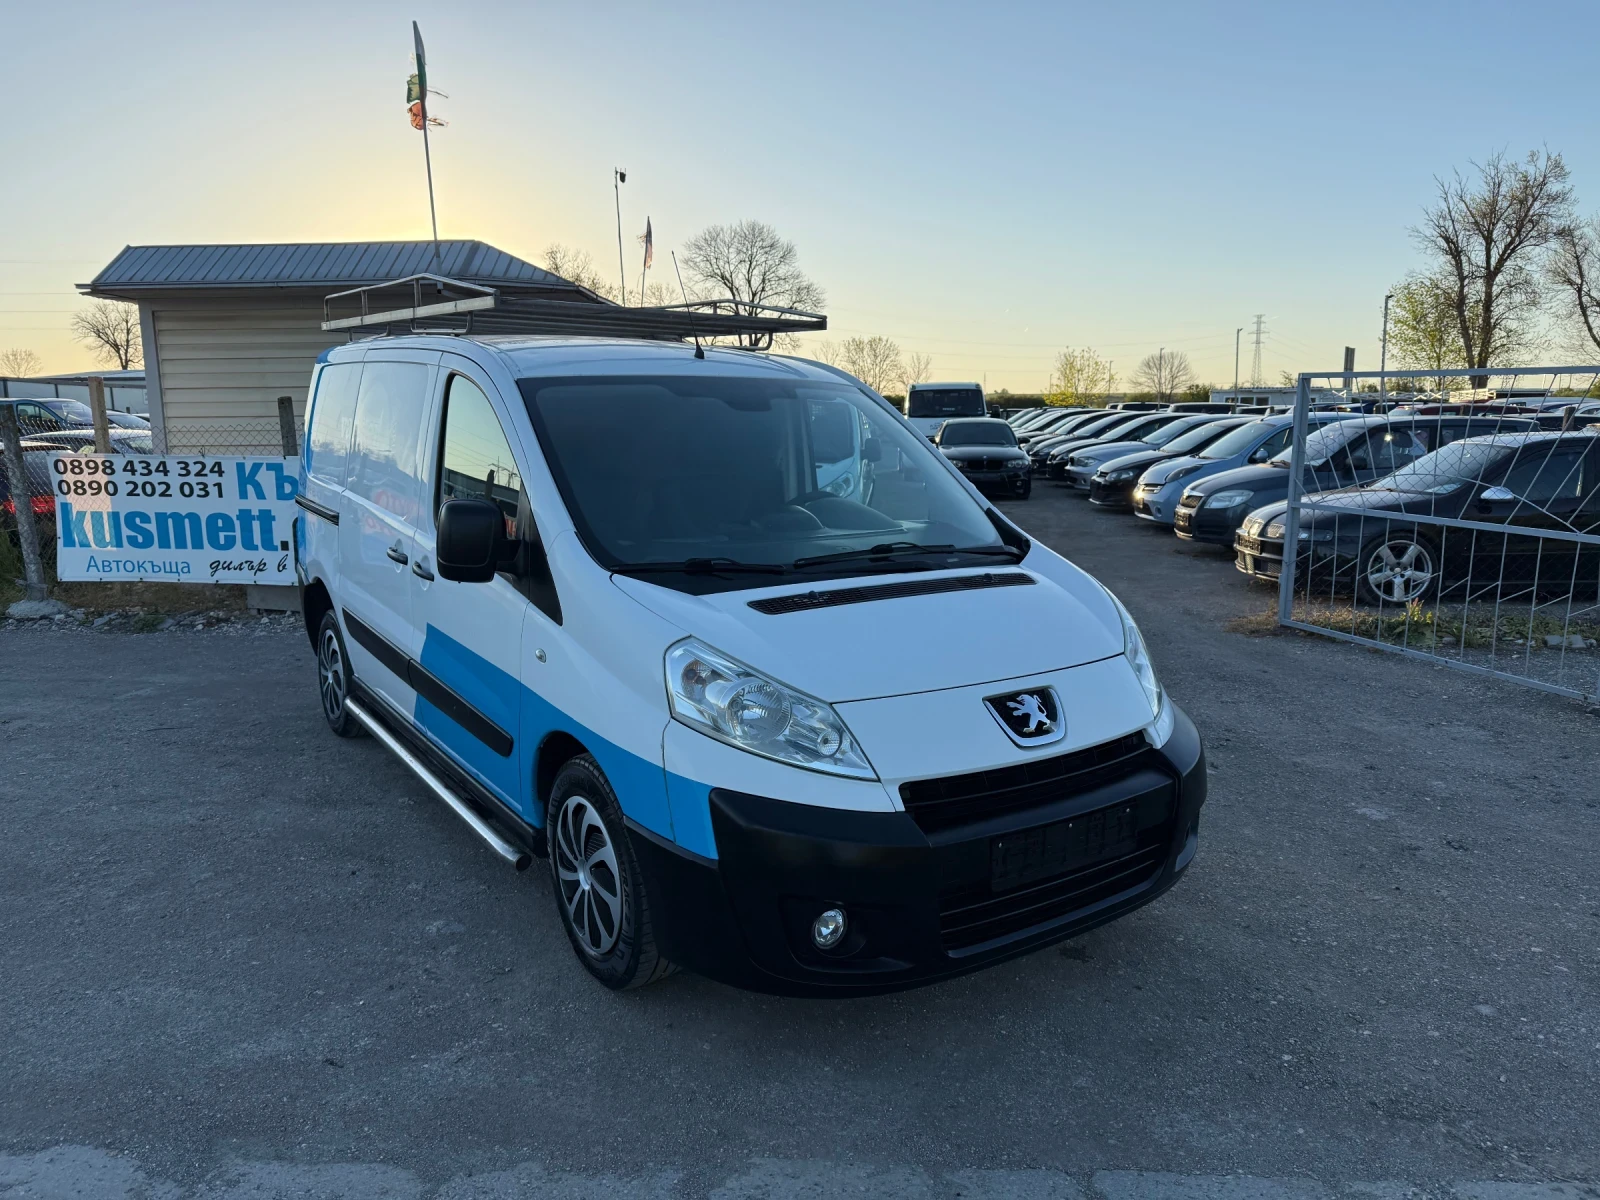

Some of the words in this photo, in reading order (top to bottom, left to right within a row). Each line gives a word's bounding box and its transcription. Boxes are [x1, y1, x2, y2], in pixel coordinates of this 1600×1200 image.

[53, 458, 116, 476] 0898
[122, 460, 170, 477] 434
[177, 461, 225, 478] 324
[57, 479, 119, 497] 0890
[125, 480, 173, 498] 202
[179, 481, 224, 499] 031
[86, 555, 191, 577] Автокъща
